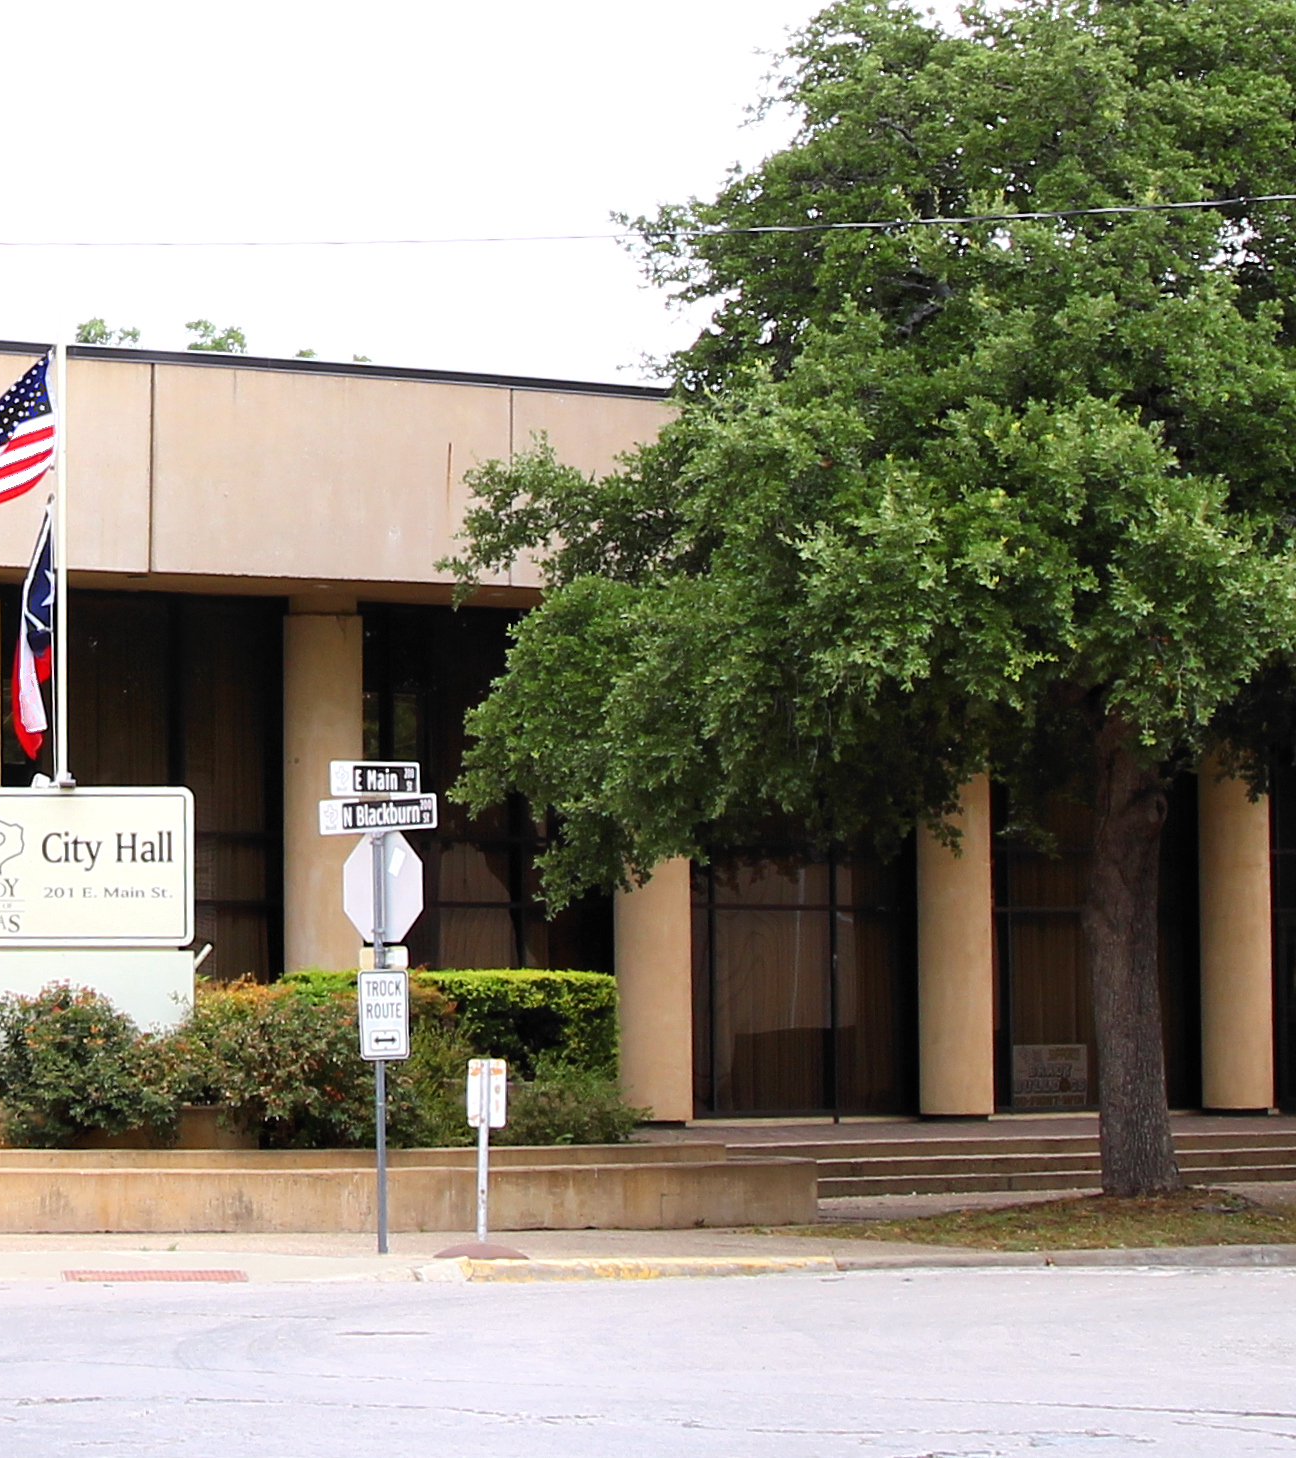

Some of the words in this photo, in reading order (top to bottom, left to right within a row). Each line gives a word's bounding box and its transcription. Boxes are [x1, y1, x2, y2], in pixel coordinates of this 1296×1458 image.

[354, 769, 363, 790] E
[366, 768, 399, 791] Main
[343, 806, 353, 827] N
[355, 802, 421, 827] Blackburn
[41, 831, 104, 871] City
[115, 830, 174, 863] Hall
[43, 886, 75, 899] 201
[82, 886, 98, 899] E.
[104, 886, 145, 899] Main
[150, 886, 174, 899] St.
[366, 1002, 403, 1020] ROUTE
